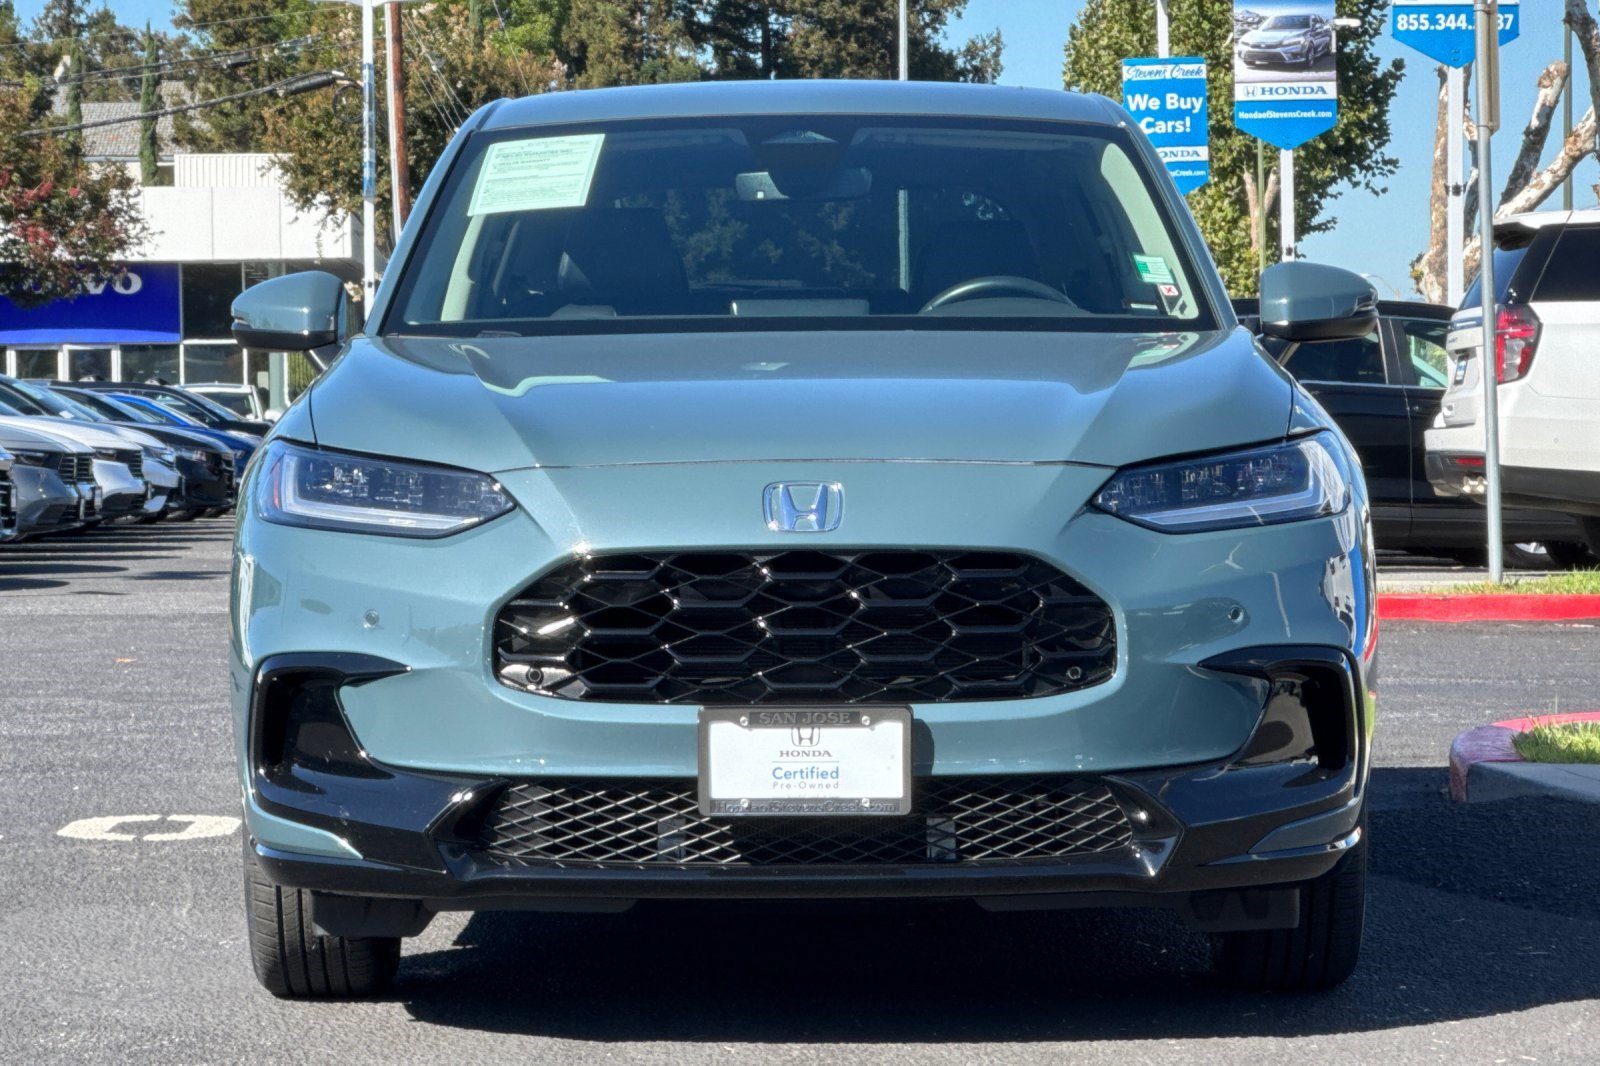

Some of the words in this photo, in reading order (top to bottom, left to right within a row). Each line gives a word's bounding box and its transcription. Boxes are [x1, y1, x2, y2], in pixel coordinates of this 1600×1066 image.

[1170, 64, 1204, 79] Creek
[1260, 85, 1328, 95] HONDA
[1126, 93, 1161, 112] We
[1165, 92, 1204, 114] Buy
[1239, 109, 1333, 119] HondaofStevensCreek.com
[1140, 116, 1191, 134] Cars!
[759, 712, 797, 724] SAN
[802, 712, 851, 724] JOSE
[772, 766, 839, 780] Certified
[772, 781, 839, 789] Pre-Owned
